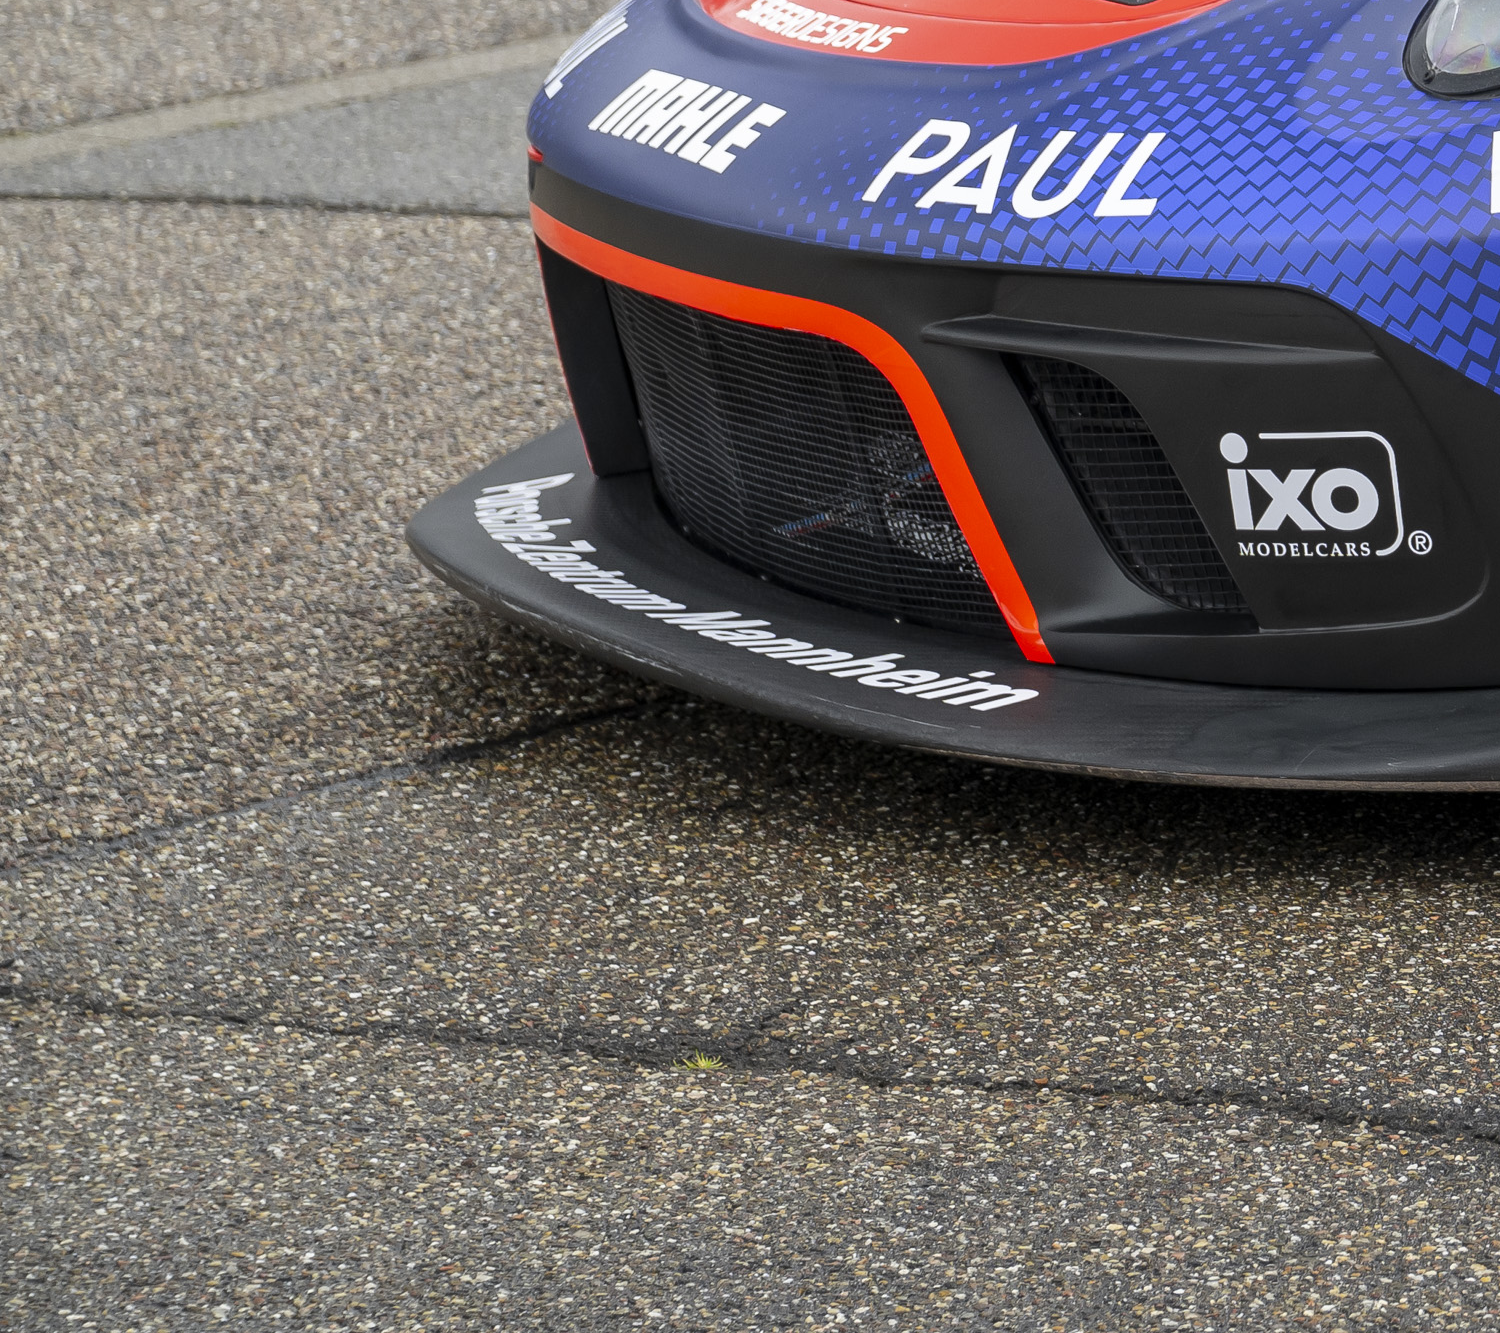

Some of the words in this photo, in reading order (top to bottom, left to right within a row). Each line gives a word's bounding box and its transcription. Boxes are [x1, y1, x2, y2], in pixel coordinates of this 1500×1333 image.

[588, 68, 787, 174] MAHLE
[862, 119, 1167, 219] PAUL
[1237, 541, 1371, 558] MODELCARS
[501, 539, 687, 611] Zentrum
[644, 610, 1040, 712] Mannheim
